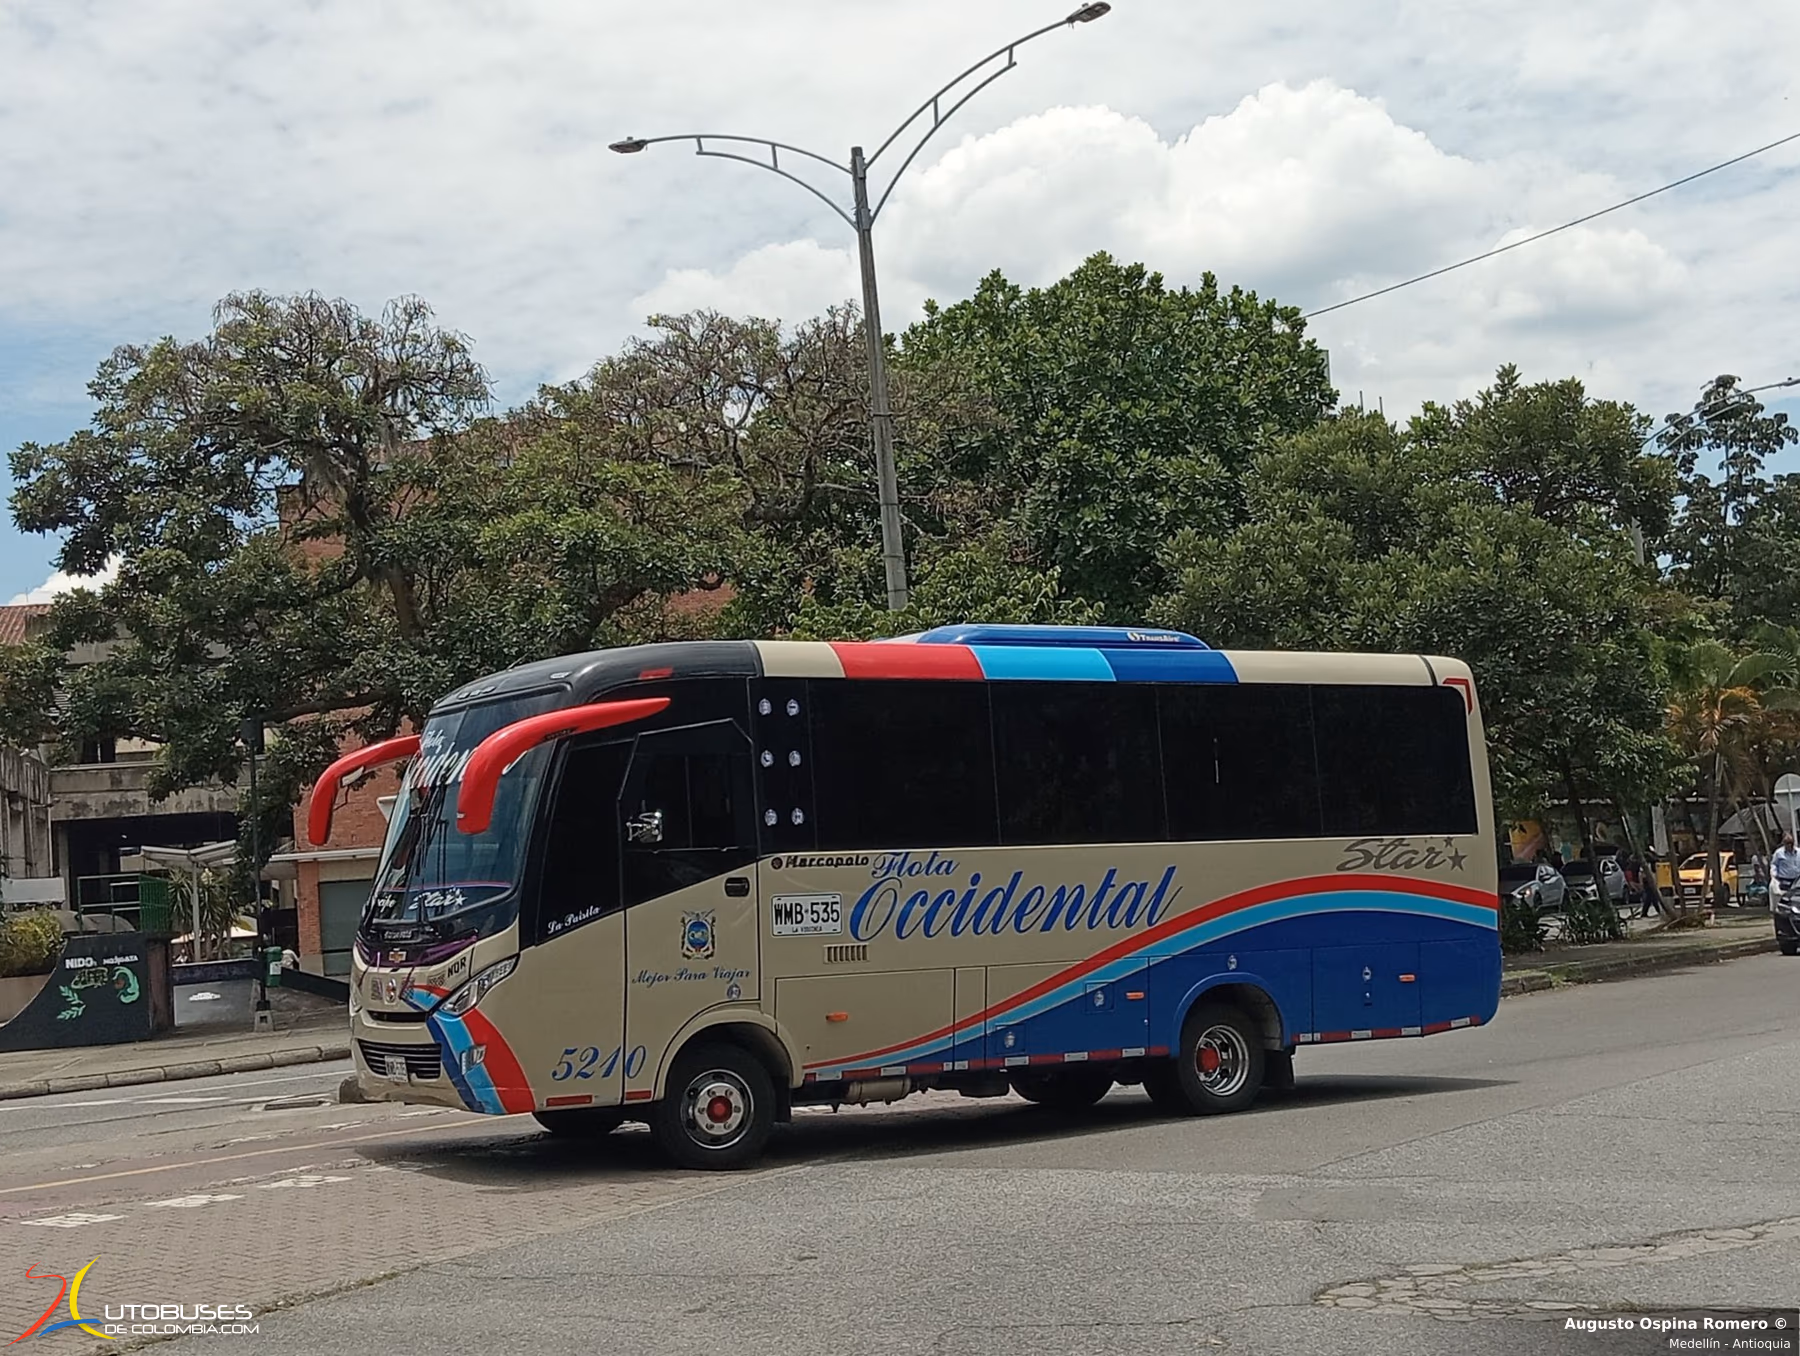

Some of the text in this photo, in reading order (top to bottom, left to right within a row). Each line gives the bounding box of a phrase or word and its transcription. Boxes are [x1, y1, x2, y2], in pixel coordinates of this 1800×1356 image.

[870, 850, 961, 879] Flota
[1336, 838, 1447, 872] Star
[849, 865, 1184, 942] Occidental
[631, 964, 752, 989] Mejor Para Viajar
[551, 1044, 647, 1081] 5210
